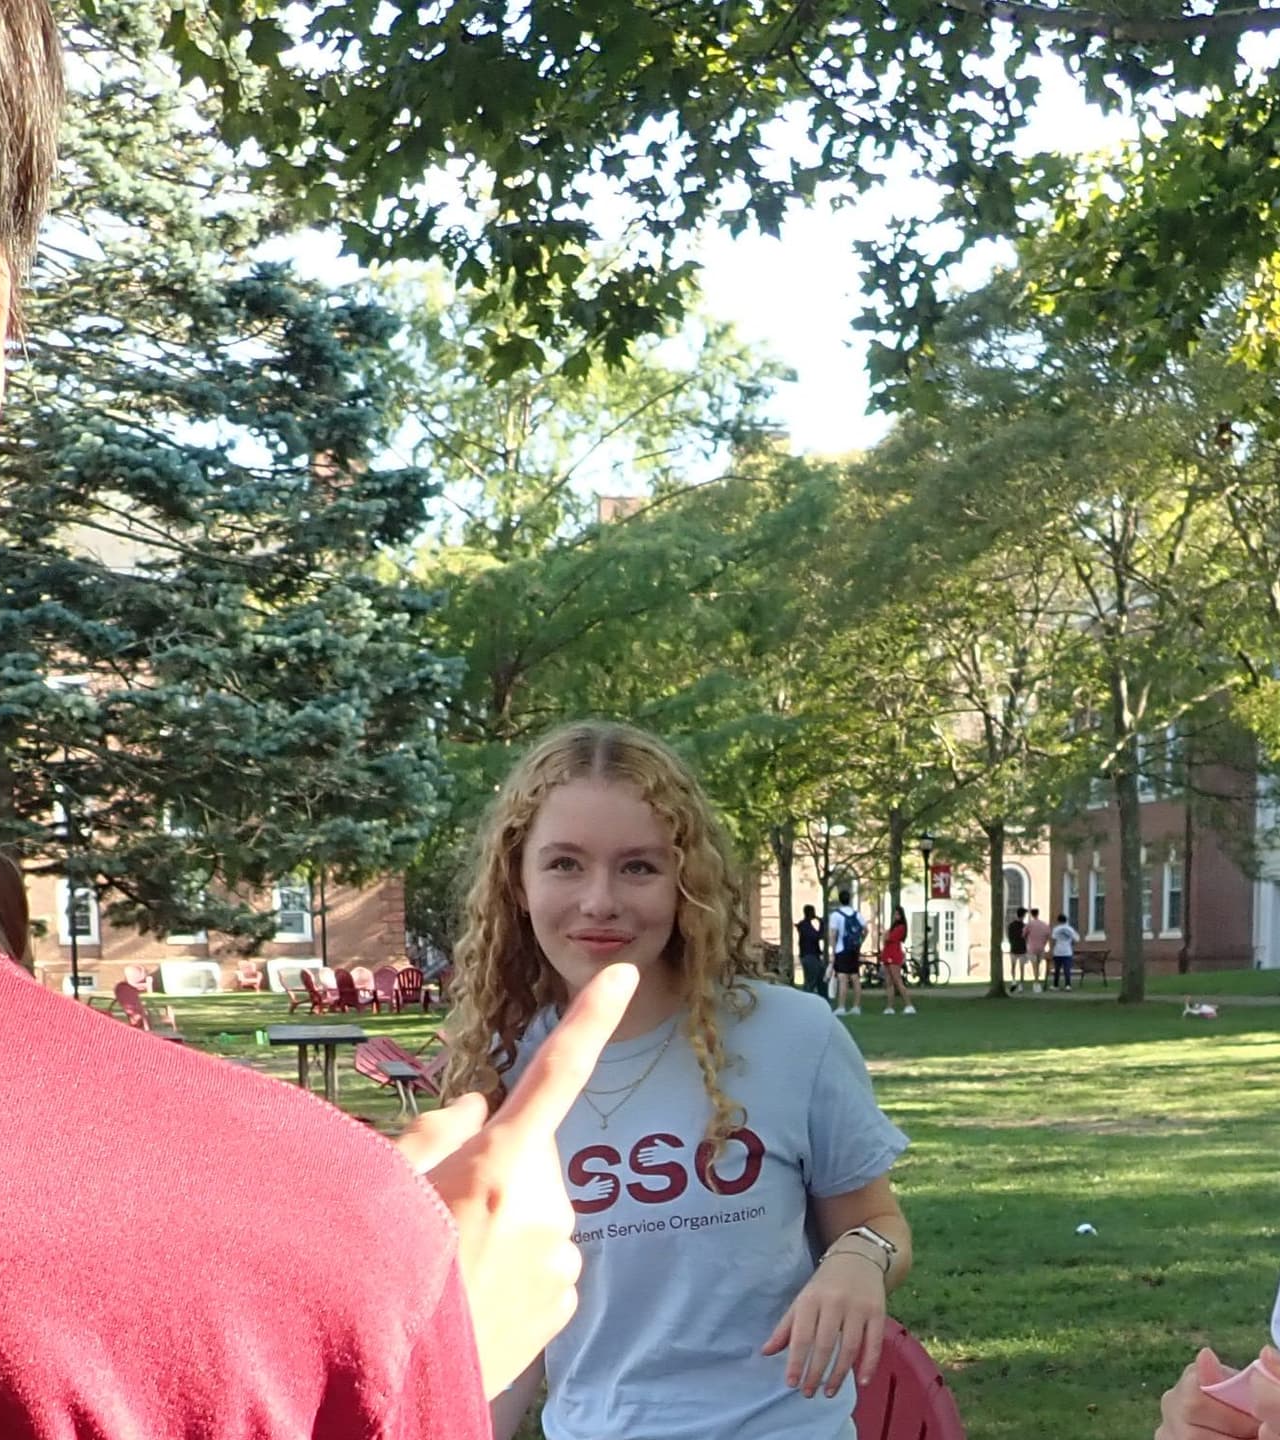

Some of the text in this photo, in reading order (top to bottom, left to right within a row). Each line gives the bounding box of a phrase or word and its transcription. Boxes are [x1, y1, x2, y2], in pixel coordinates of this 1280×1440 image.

[567, 1127, 766, 1214] SSO
[571, 1206, 766, 1245] dent Service Organization
